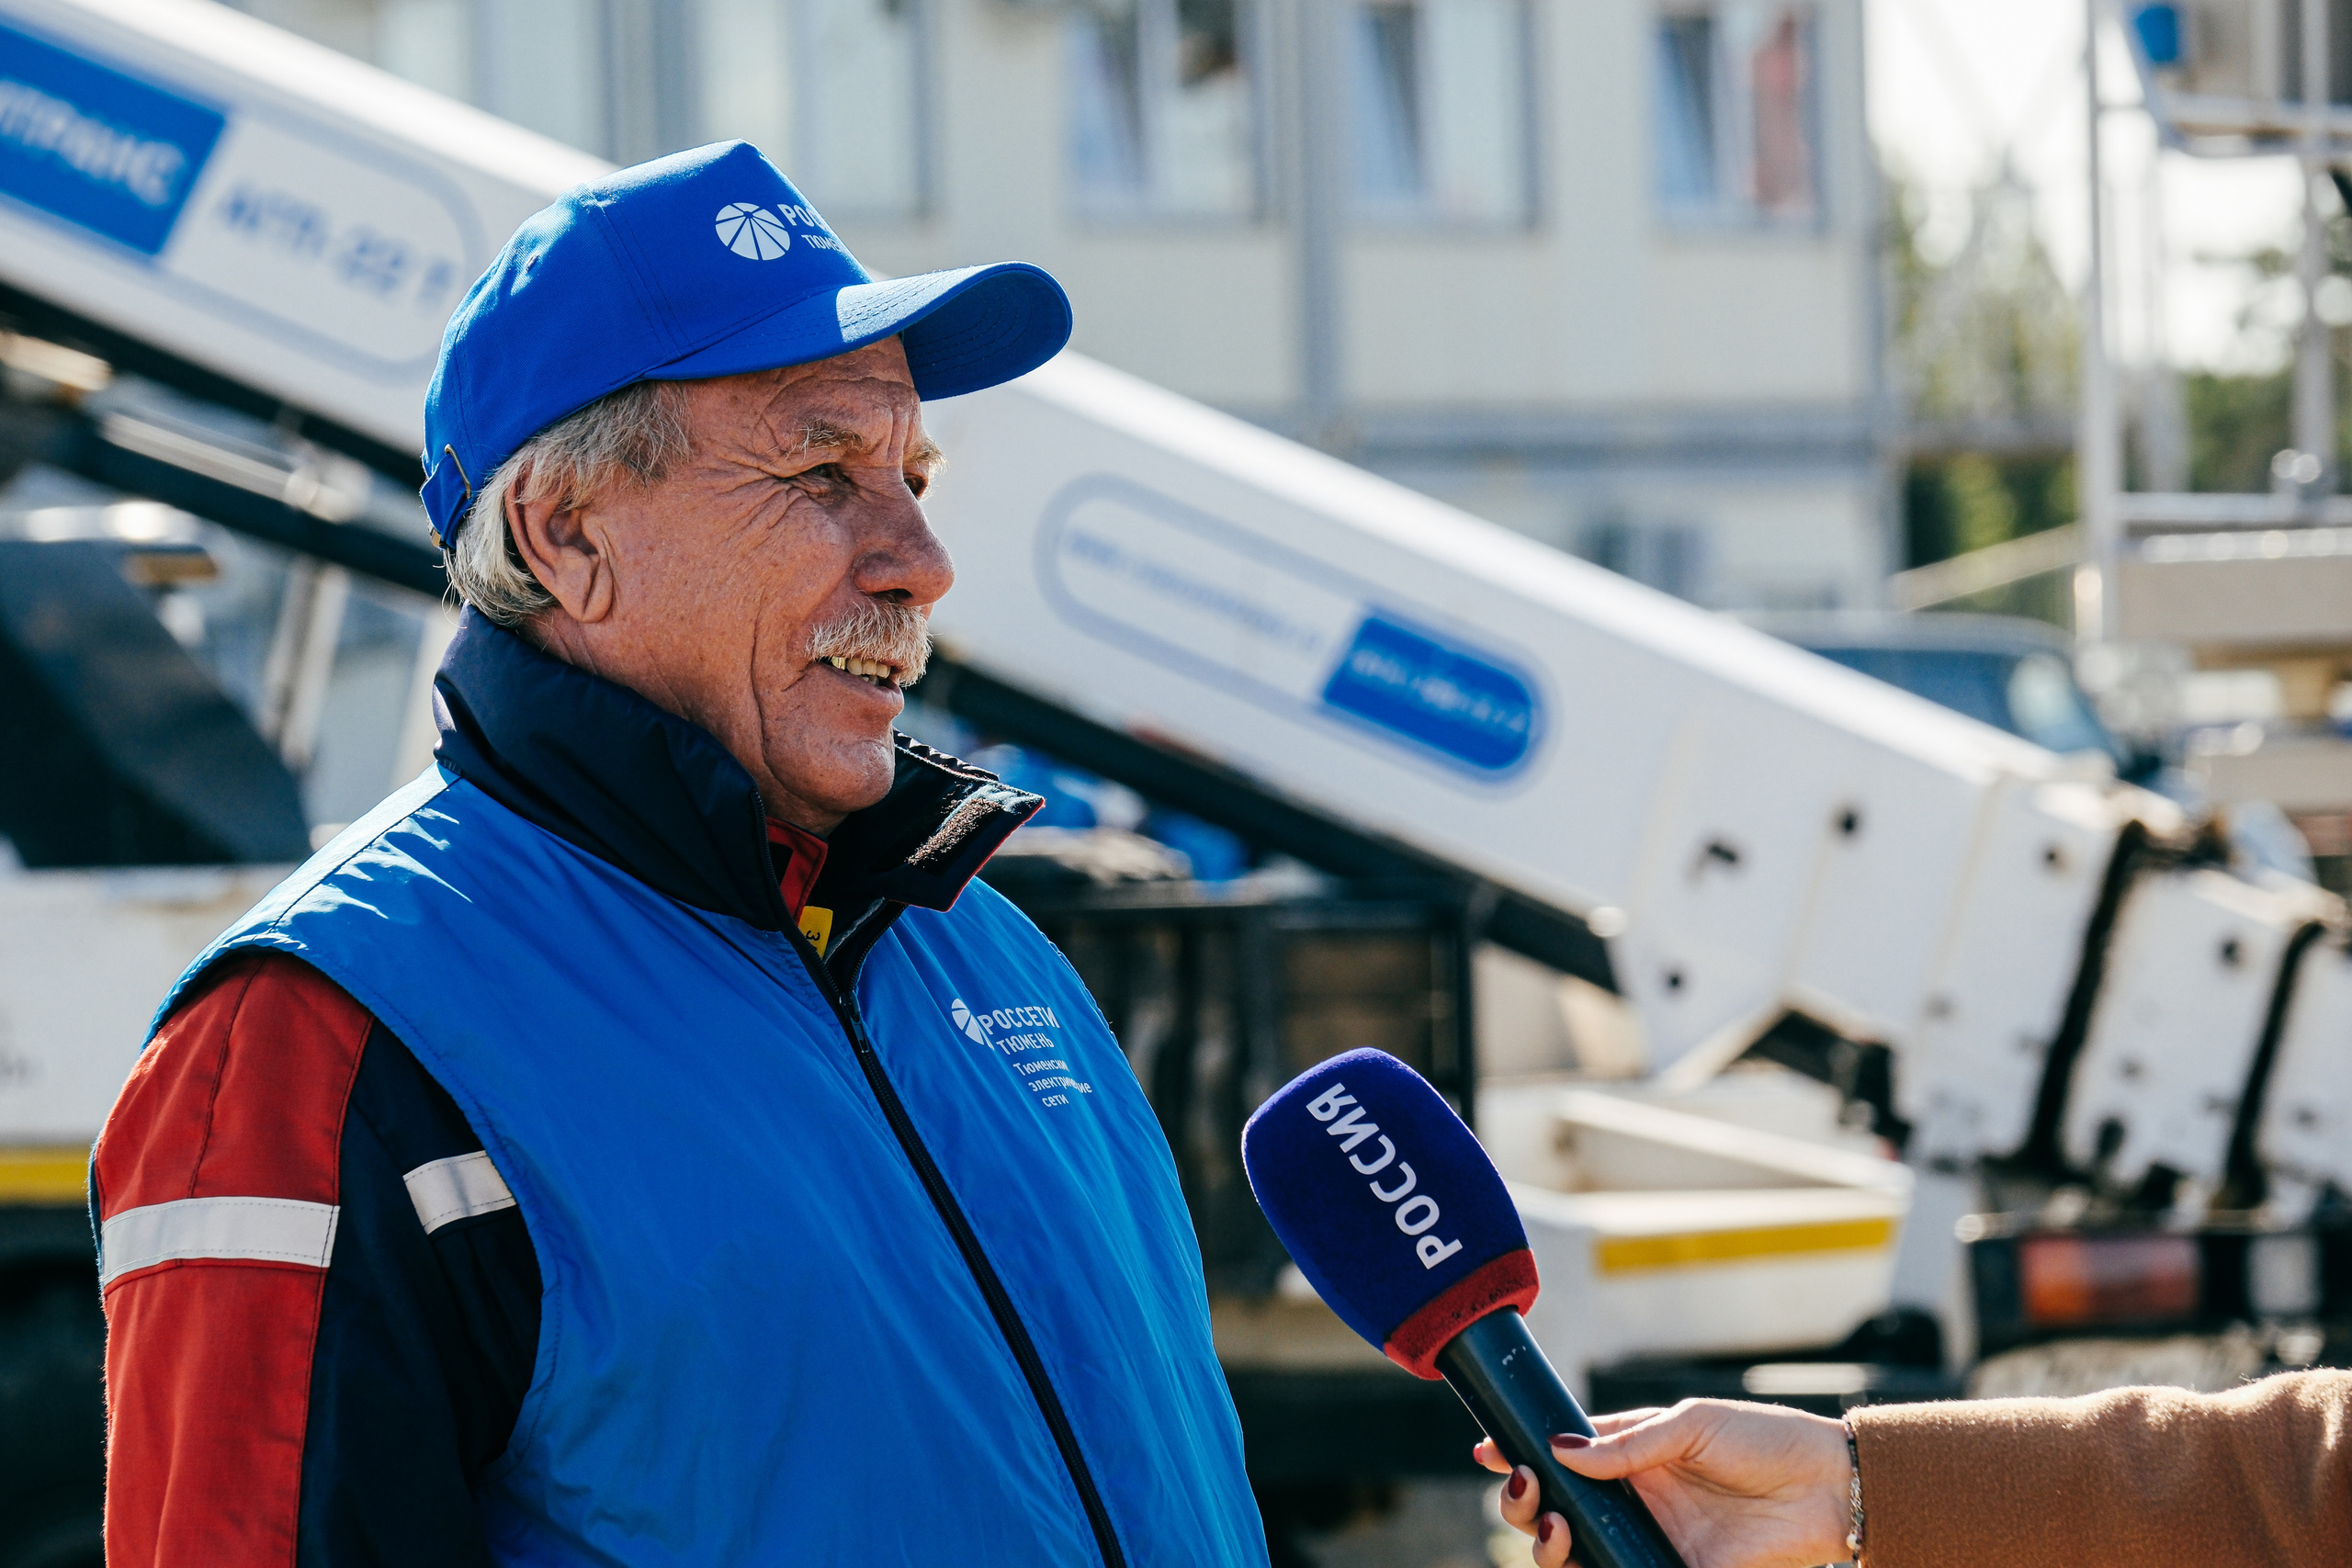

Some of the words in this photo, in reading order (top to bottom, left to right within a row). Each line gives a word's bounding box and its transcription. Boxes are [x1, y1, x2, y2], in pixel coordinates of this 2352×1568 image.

[977, 1006, 1060, 1035] РОССЕТИ
[996, 1032, 1055, 1055] ТЮМЕНЬ
[1042, 1094, 1069, 1108] сети
[1306, 1082, 1464, 1270] РОССИЯ
